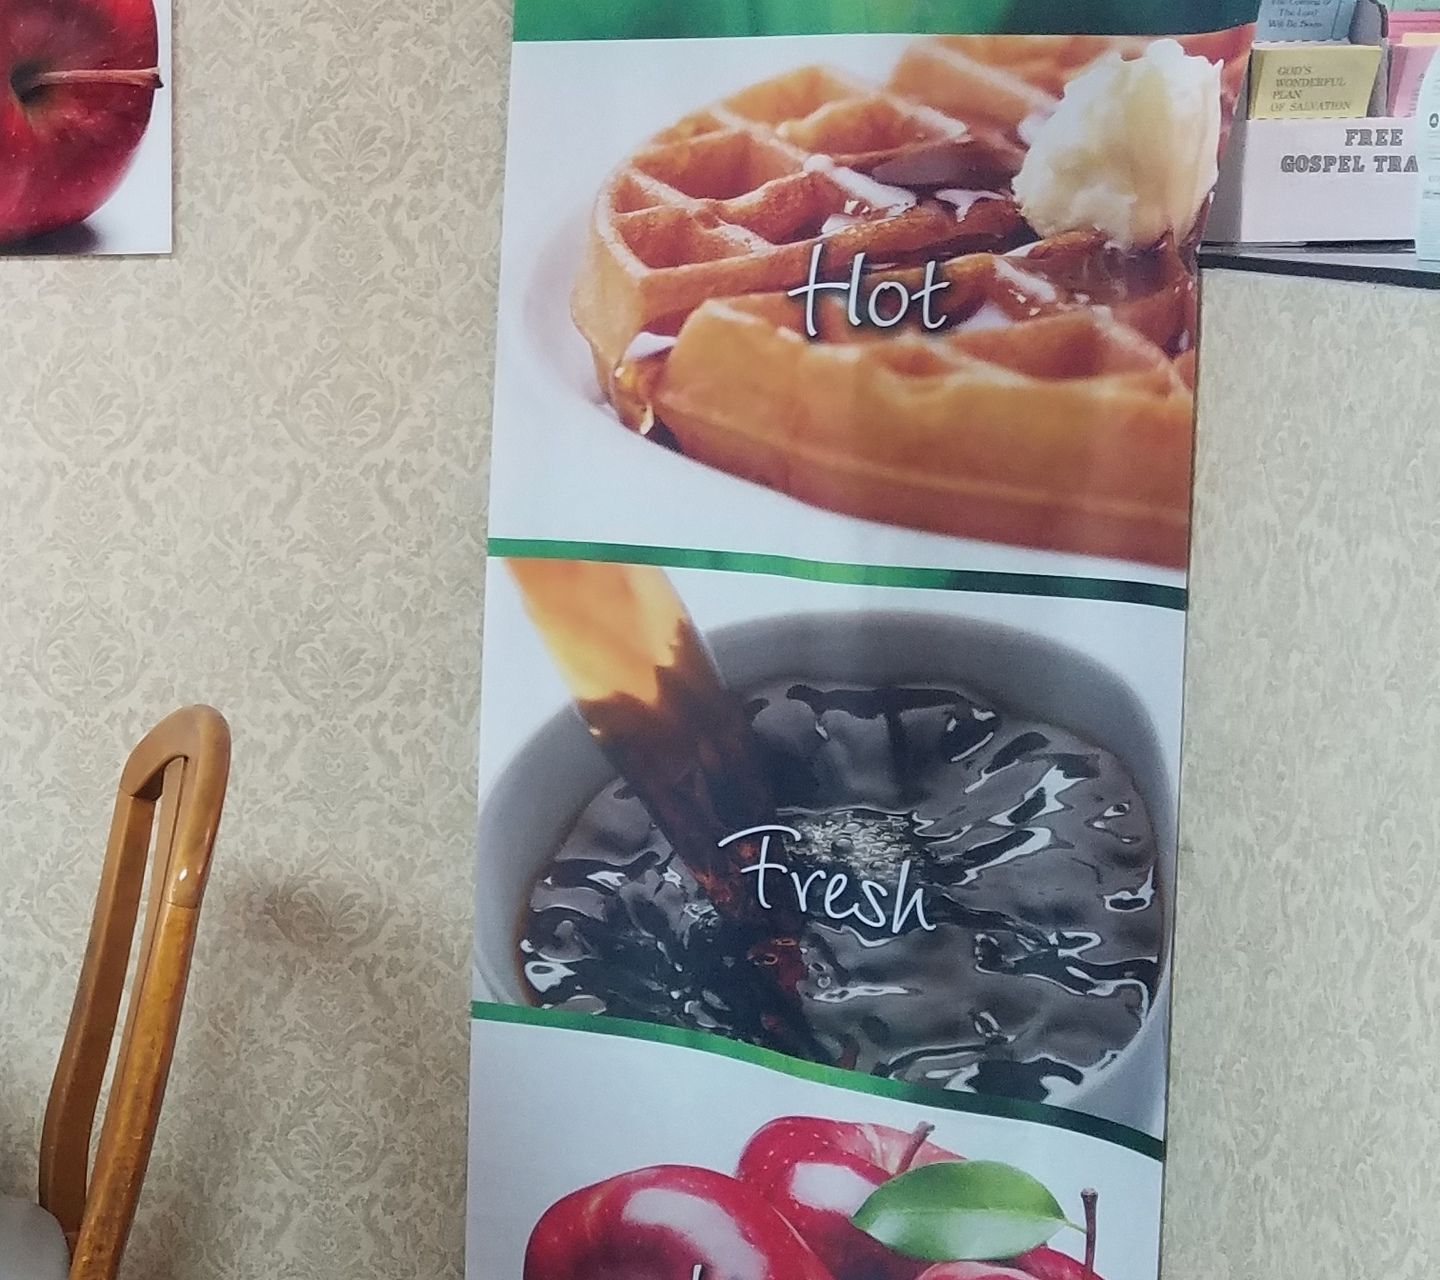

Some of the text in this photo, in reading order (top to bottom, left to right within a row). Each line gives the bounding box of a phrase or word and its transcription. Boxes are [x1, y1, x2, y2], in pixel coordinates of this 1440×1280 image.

[1275, 77, 1346, 88] WONDERFUL
[1272, 89, 1302, 100] PLAN
[1270, 101, 1352, 113] OF SALVATION
[1344, 128, 1404, 147] FREE
[1280, 154, 1420, 174] GOSPEL TRA
[787, 243, 951, 338] Hot
[717, 824, 937, 934] Fresh
